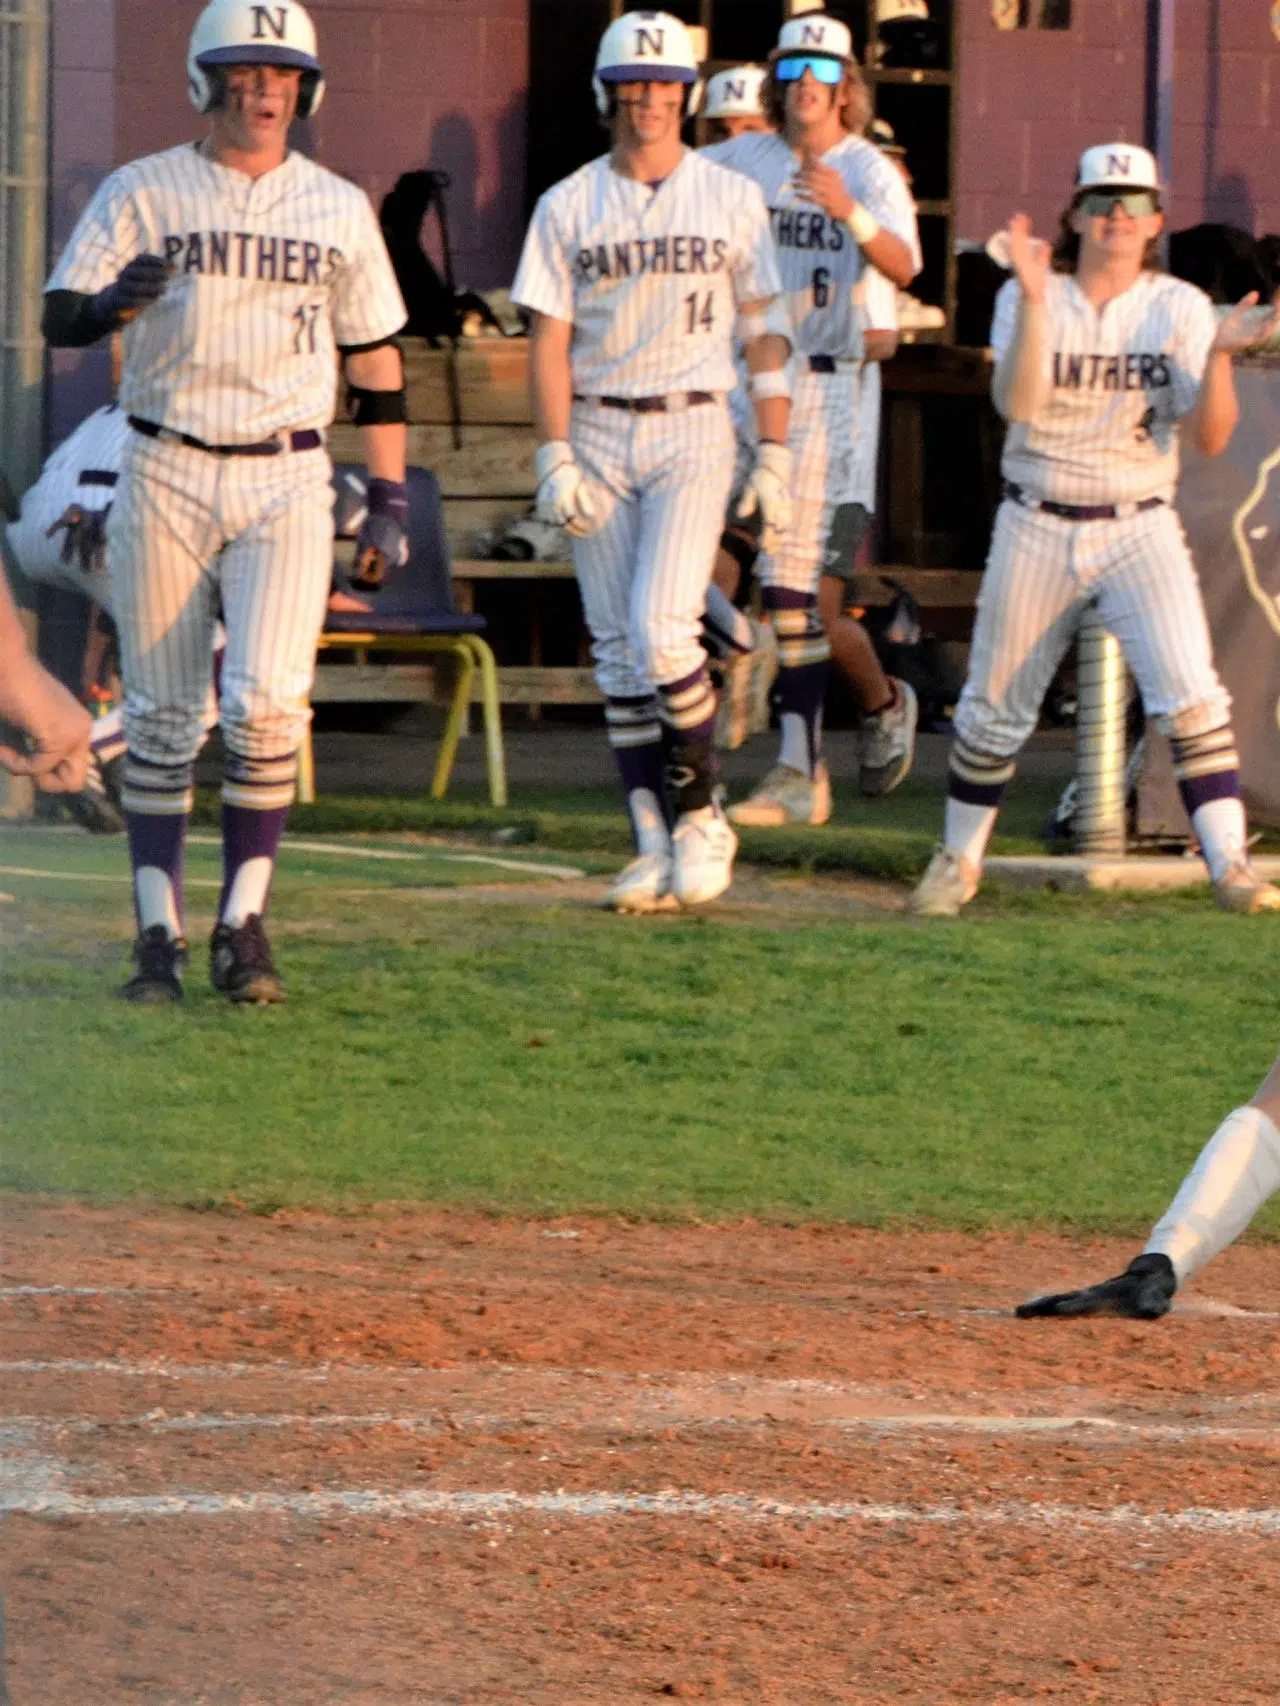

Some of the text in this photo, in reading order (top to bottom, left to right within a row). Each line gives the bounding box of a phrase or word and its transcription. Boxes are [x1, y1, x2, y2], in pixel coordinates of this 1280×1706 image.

[251, 6, 287, 39] N
[801, 26, 826, 45] N
[635, 28, 664, 56] N
[724, 81, 746, 100] N
[1105, 154, 1131, 176] N
[164, 231, 345, 285] PANTHERS
[577, 236, 728, 280] PANTHERS
[813, 268, 829, 308] 6
[685, 290, 715, 334] 14
